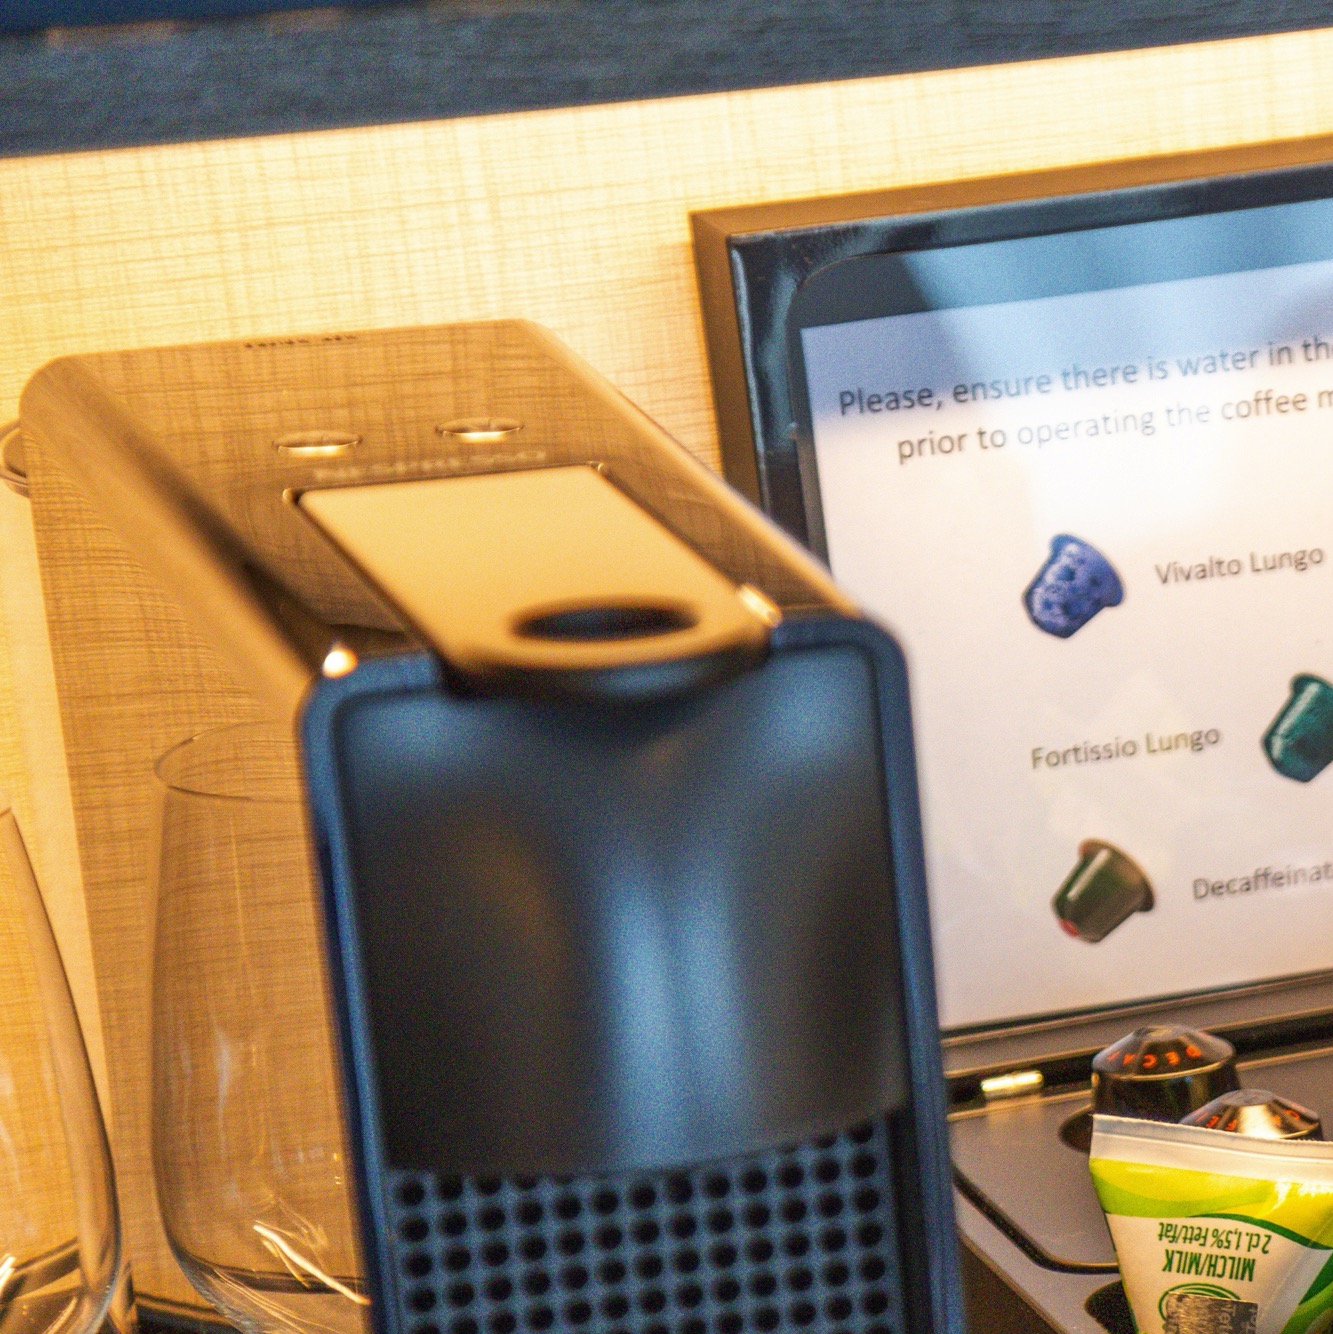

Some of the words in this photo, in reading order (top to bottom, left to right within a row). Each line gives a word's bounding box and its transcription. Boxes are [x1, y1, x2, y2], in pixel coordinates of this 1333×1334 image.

[838, 387, 944, 416] Please,
[953, 374, 1052, 403] ensure
[1061, 361, 1138, 391] there
[1147, 356, 1169, 381] is
[1177, 348, 1259, 377] water
[1267, 342, 1294, 366] in
[897, 431, 968, 465] prior
[977, 427, 1007, 450] to
[1017, 410, 1156, 448] operating
[1165, 401, 1210, 427] the
[1222, 389, 1308, 420] coffee
[1155, 555, 1242, 584] Vivalto
[1250, 547, 1324, 573] Lungo
[1031, 737, 1138, 769] Fortissio
[1145, 728, 1221, 754] Lungo
[1157, 1222, 1209, 1247] Fett/fat
[1210, 1228, 1243, 1250] 1,5%
[1261, 1234, 1272, 1254] 2
[1161, 1248, 1256, 1282] MILCH/MILK
